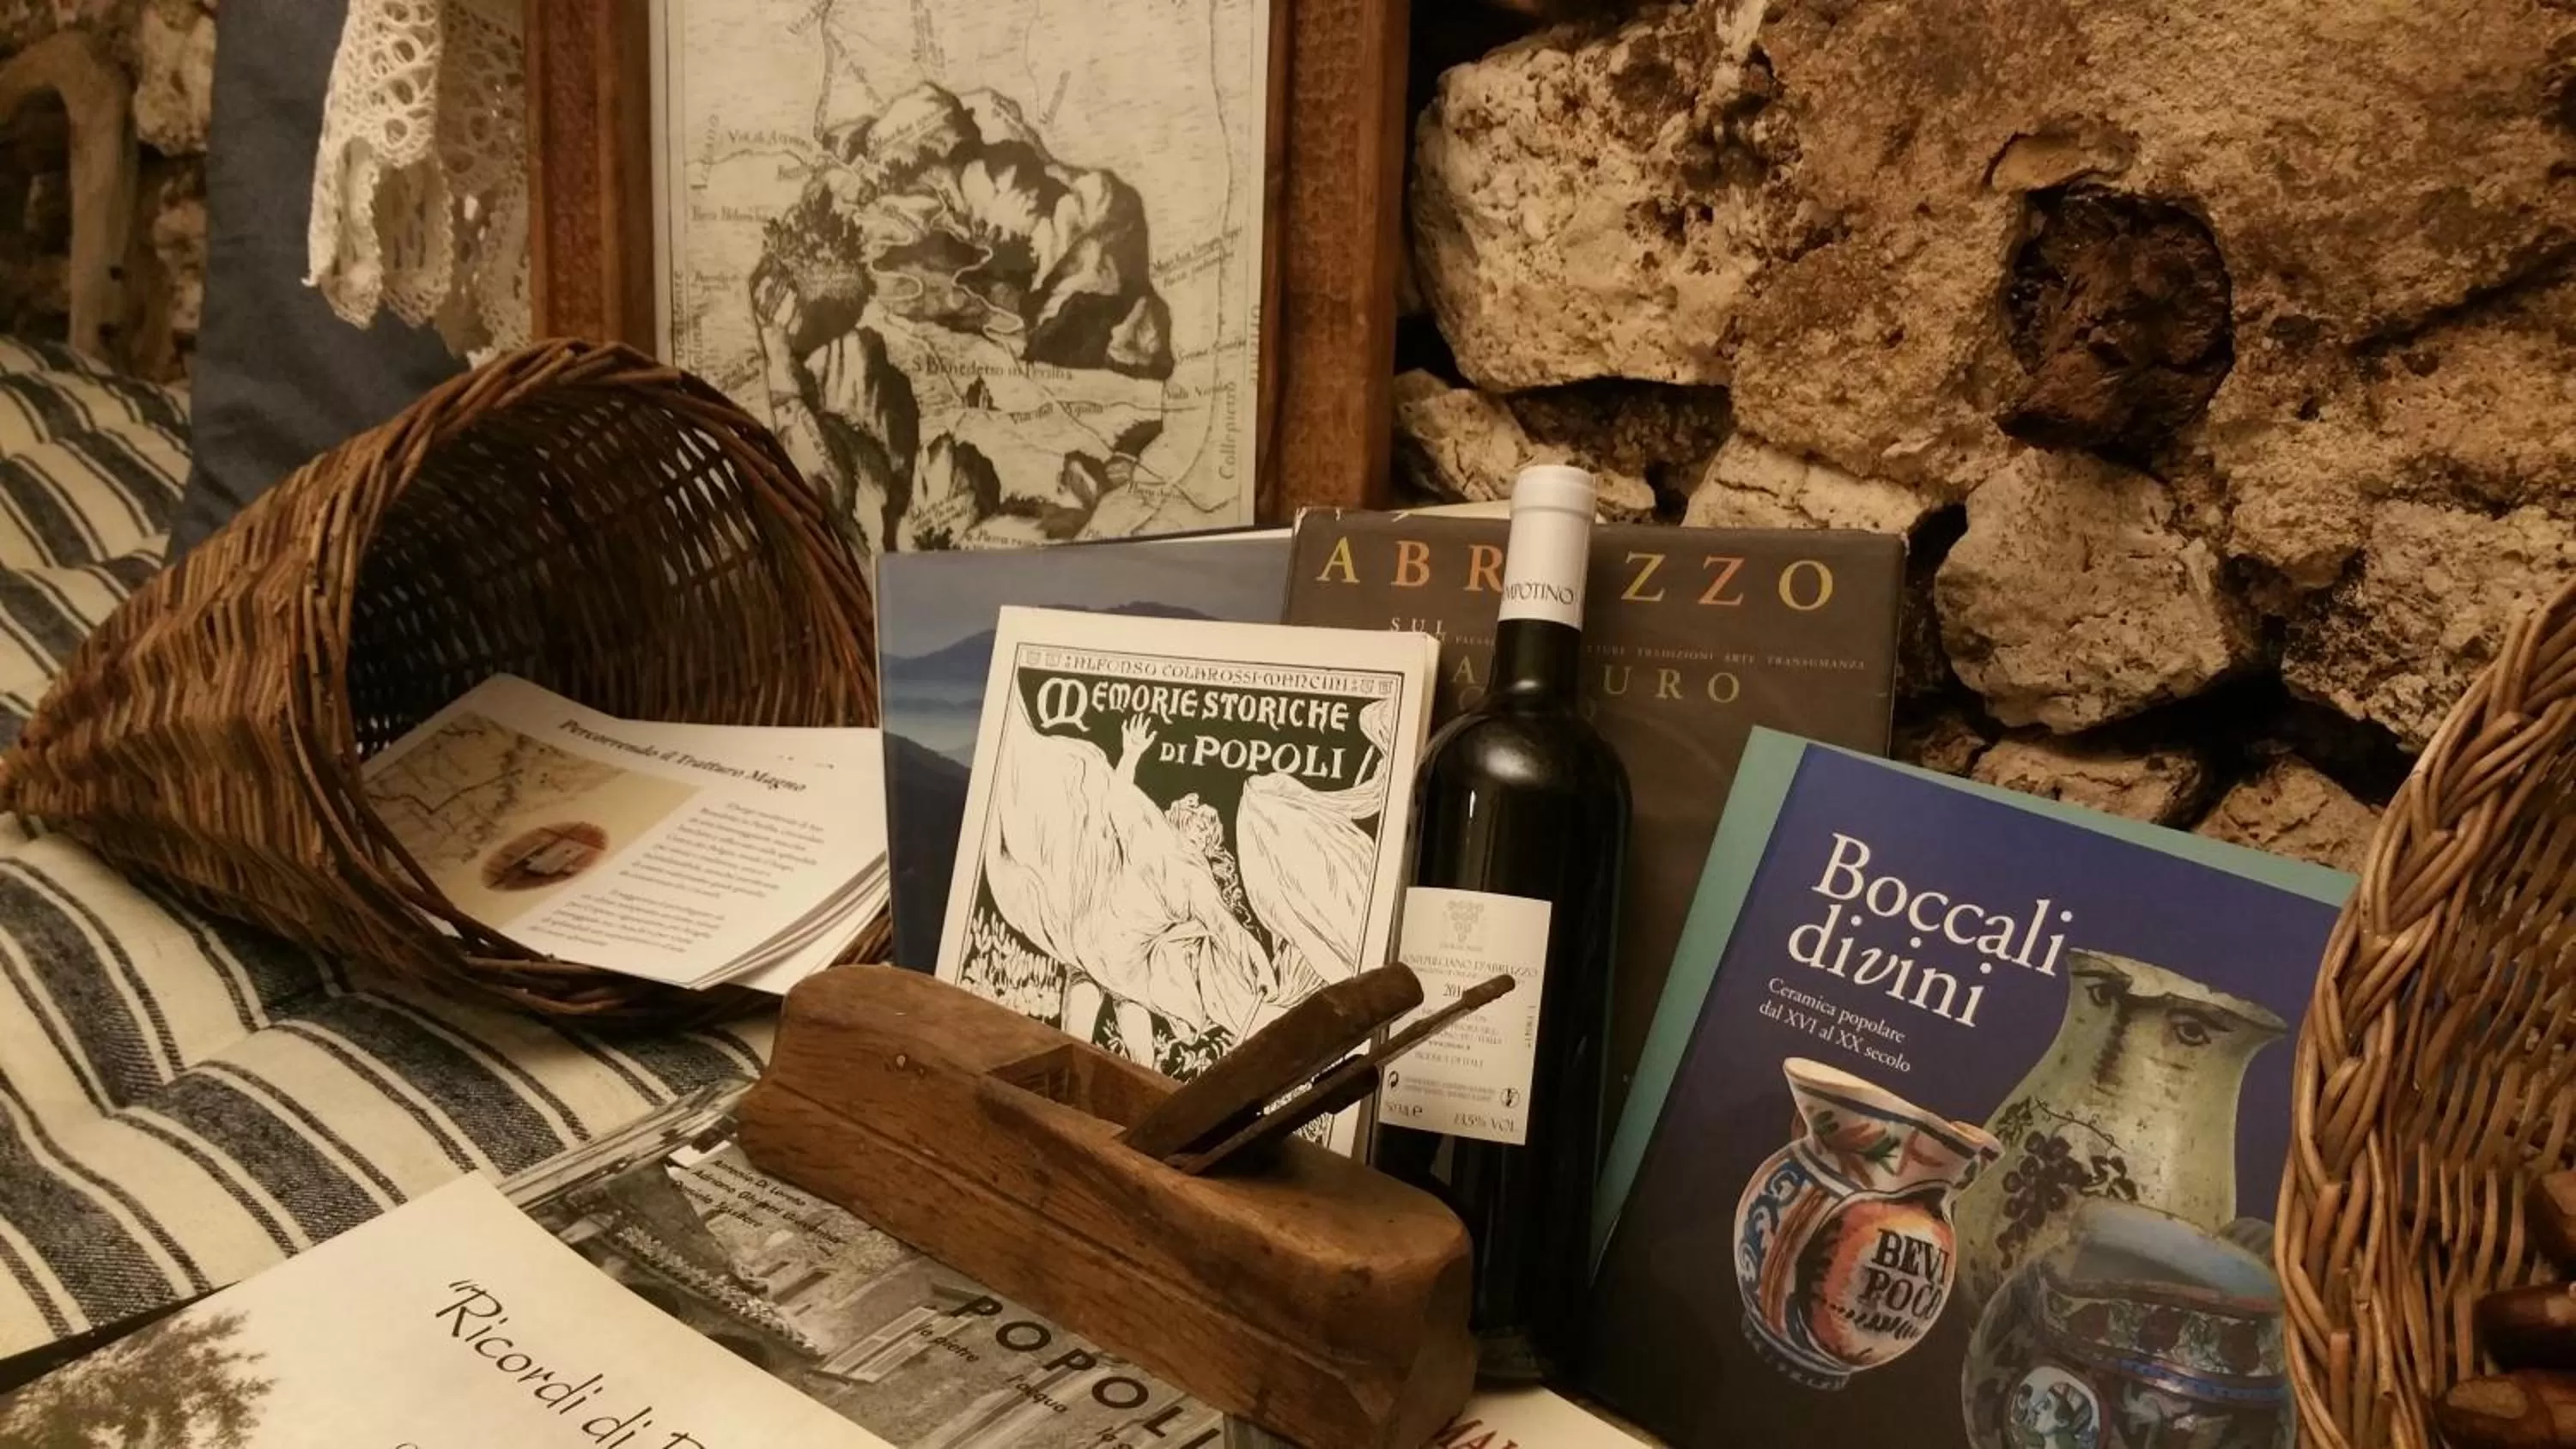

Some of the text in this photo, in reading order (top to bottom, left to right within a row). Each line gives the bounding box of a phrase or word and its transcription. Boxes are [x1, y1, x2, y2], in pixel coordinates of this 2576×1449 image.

[1316, 536, 1834, 611] ABRZZO
[1505, 581, 1574, 605] MPOTINO
[1201, 689, 1349, 733] STORICHE
[559, 718, 659, 757] Percorrendo
[677, 754, 744, 779] Tratturo
[744, 769, 807, 792] Magno
[1159, 735, 1346, 779] DI POPOLI
[1811, 831, 2075, 977] Boccali
[1788, 904, 1993, 1028] divini
[1758, 1000, 1911, 1073] dal XVI al XX secolo
[1768, 976, 1907, 1045] Ceramica popolare
[1870, 1228, 1952, 1286] BEVI
[1857, 1266, 1944, 1320] POCO
[947, 1294, 1221, 1449] POPOLI
[581, 1405, 653, 1449] di
